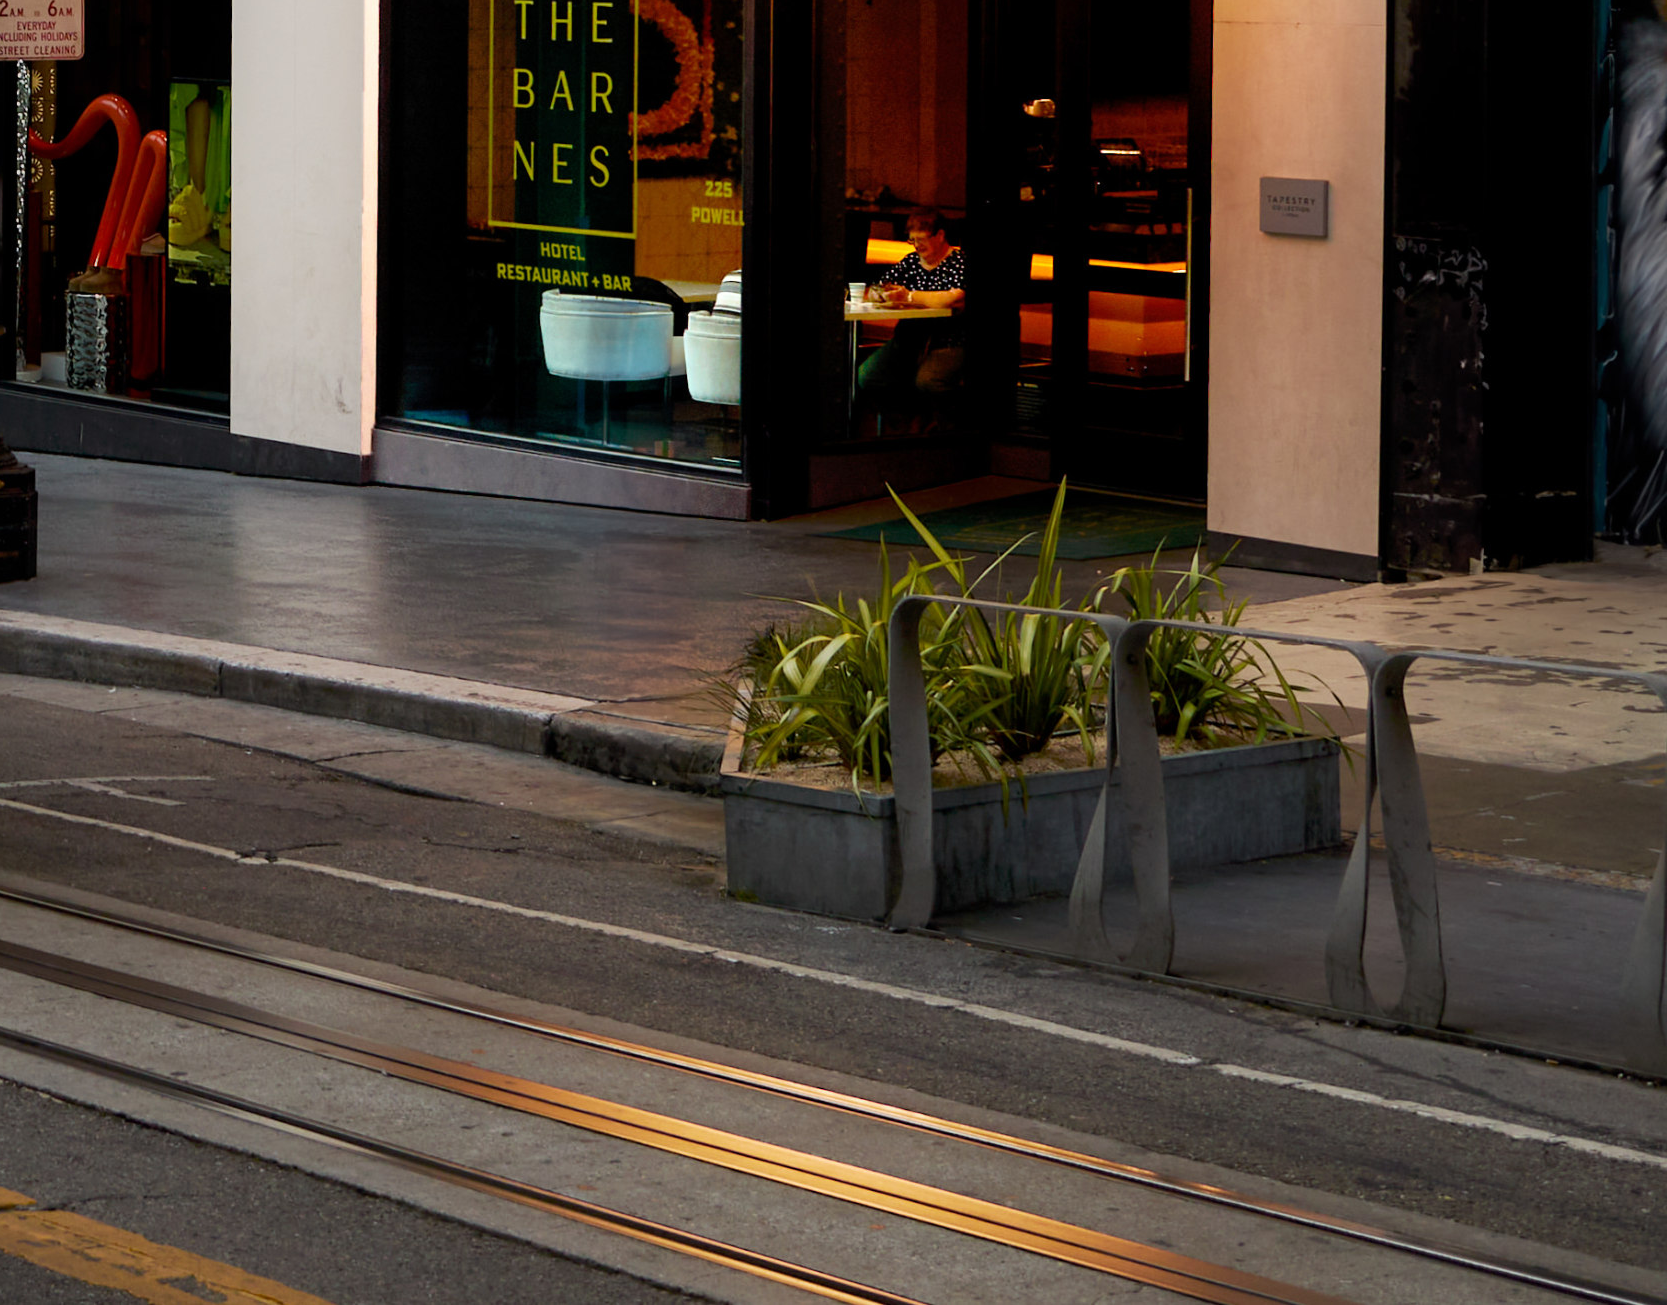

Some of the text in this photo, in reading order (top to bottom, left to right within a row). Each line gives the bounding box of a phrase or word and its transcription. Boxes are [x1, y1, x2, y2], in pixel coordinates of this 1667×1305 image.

[17, 21, 56, 30] EVERYDAY
[514, 0, 613, 43] THE
[41, 31, 78, 41] HOLIDAYS
[34, 45, 76, 55] CLEANING
[513, 67, 613, 114] BAR
[513, 140, 610, 188] NES
[705, 181, 733, 198] 225
[1267, 195, 1315, 205] TAPESTRY
[691, 207, 745, 226] POWELL
[540, 241, 586, 262] HOTEL
[497, 262, 589, 289] RESTAURANT
[602, 274, 632, 292] BAR
